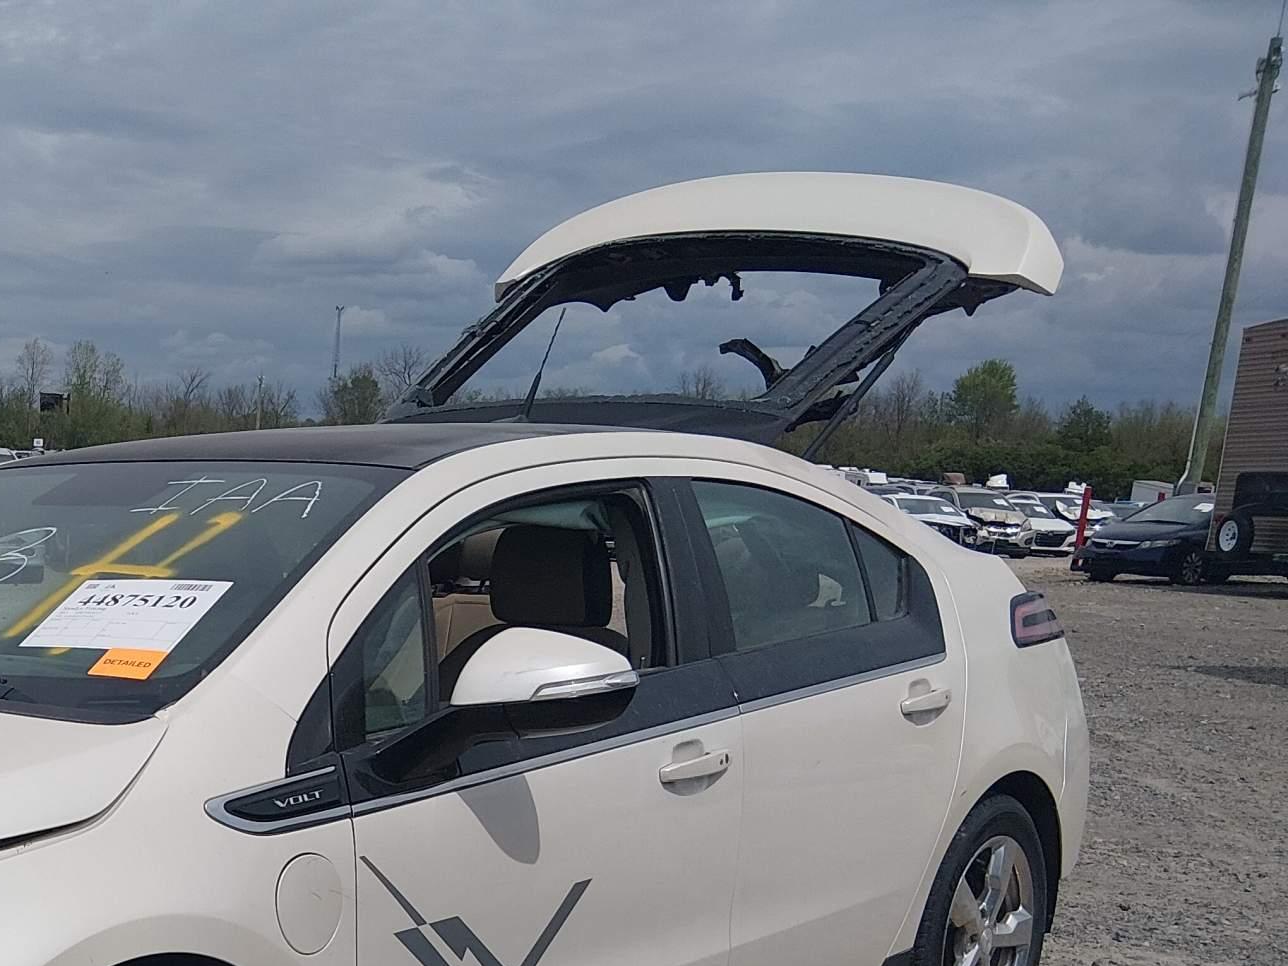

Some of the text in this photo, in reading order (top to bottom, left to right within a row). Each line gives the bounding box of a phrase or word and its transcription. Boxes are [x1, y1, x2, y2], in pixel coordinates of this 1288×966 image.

[129, 475, 322, 519] IAA
[78, 594, 198, 609] 44875120
[103, 659, 152, 668] DETAILED
[272, 789, 324, 808] VOLT
